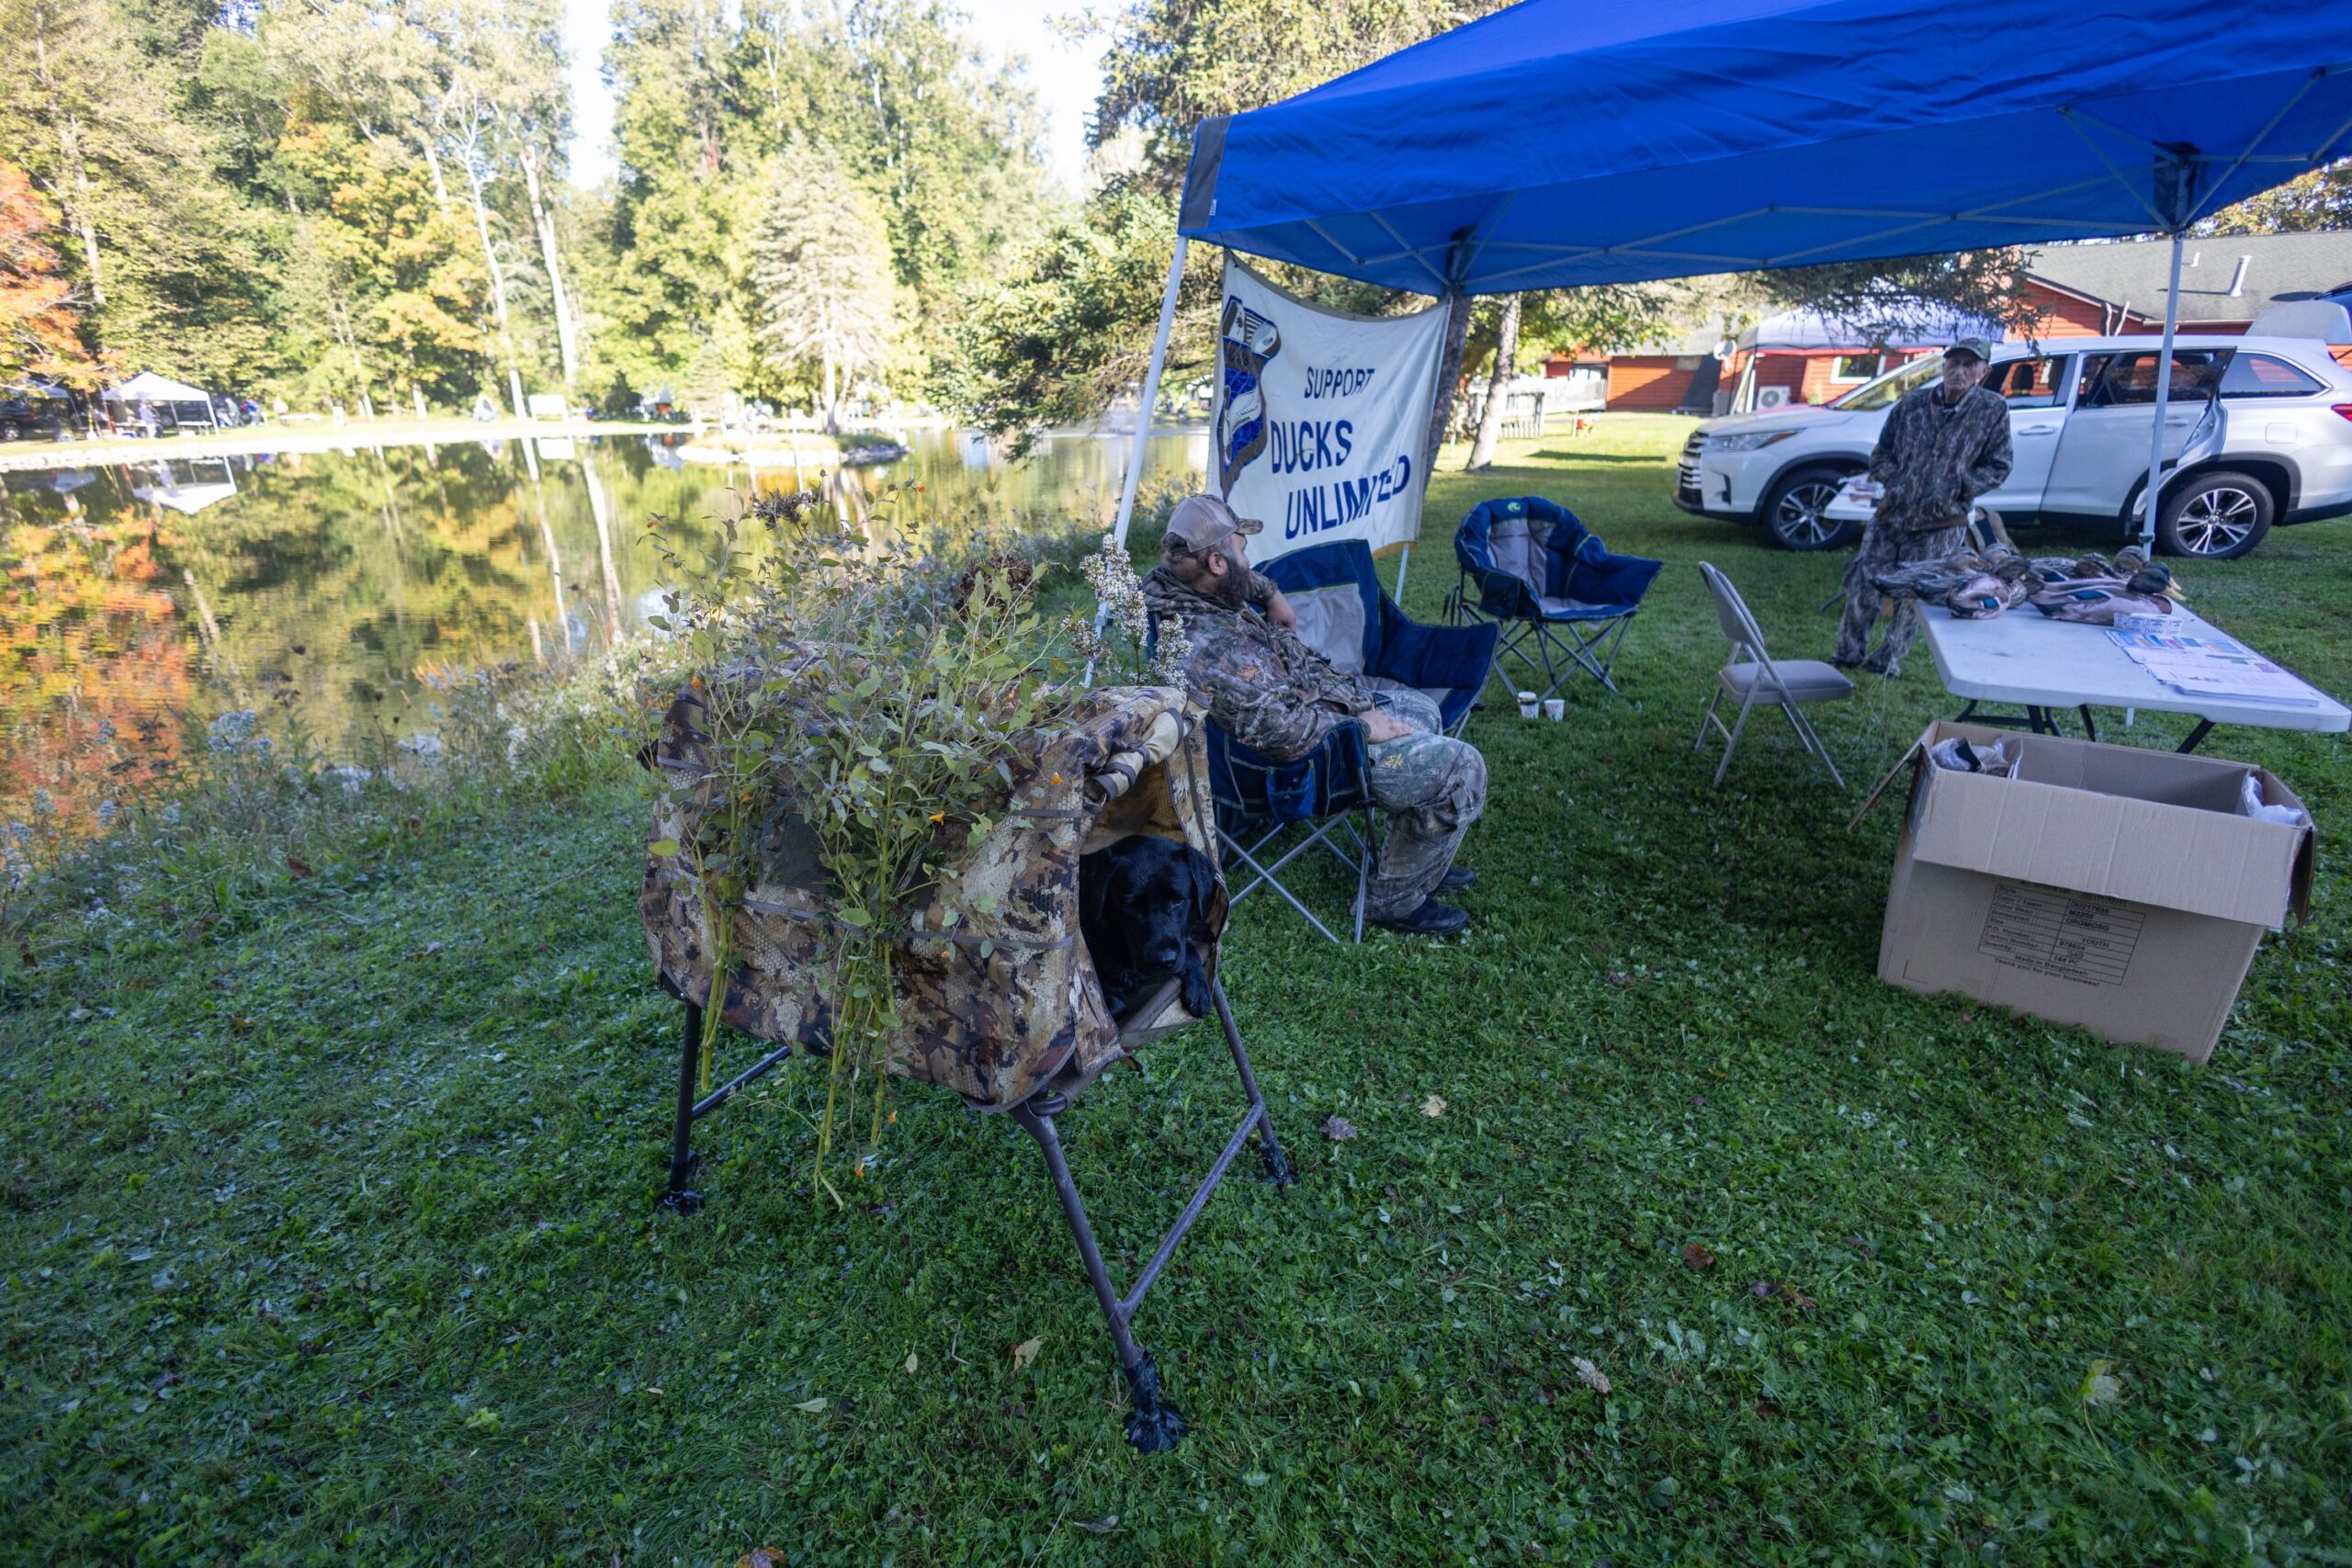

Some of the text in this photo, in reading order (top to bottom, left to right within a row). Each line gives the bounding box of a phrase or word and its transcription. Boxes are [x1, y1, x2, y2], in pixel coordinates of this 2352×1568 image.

[1305, 367, 1374, 399] SUPPORT
[1271, 420, 1353, 474] DUCKS
[1995, 902, 2013, 910] Color
[1992, 909, 2030, 921] Dimension
[1985, 932, 2038, 948] Carton Number
[2003, 929, 2030, 938] Number
[1983, 940, 2011, 952] Quantity
[2082, 937, 2109, 948] YOUTH
[2015, 954, 2034, 964] Made
[2044, 962, 2088, 976] Bangladesh
[1996, 958, 2016, 967] Thank
[2045, 970, 2061, 978] your
[2064, 974, 2099, 987] business!
